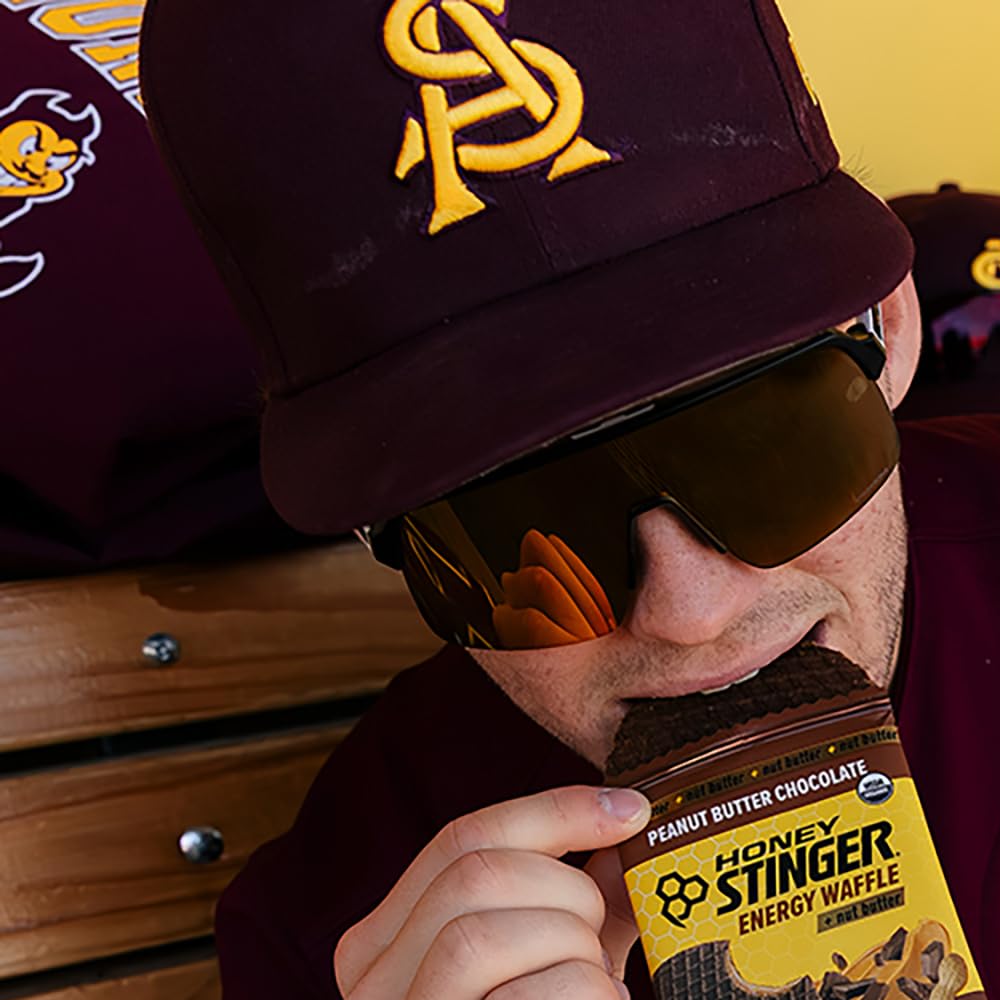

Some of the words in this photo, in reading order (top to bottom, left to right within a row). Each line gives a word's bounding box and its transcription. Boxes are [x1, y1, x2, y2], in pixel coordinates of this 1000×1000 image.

[647, 810, 708, 847] PEANUT
[711, 789, 773, 823] BUTTER
[774, 759, 868, 802] CHOCOLATE
[715, 815, 840, 872] HONEY
[738, 889, 816, 936] ENERGY
[820, 863, 900, 907] WAFFLE
[836, 904, 859, 924] nut
[861, 892, 903, 916] butter
